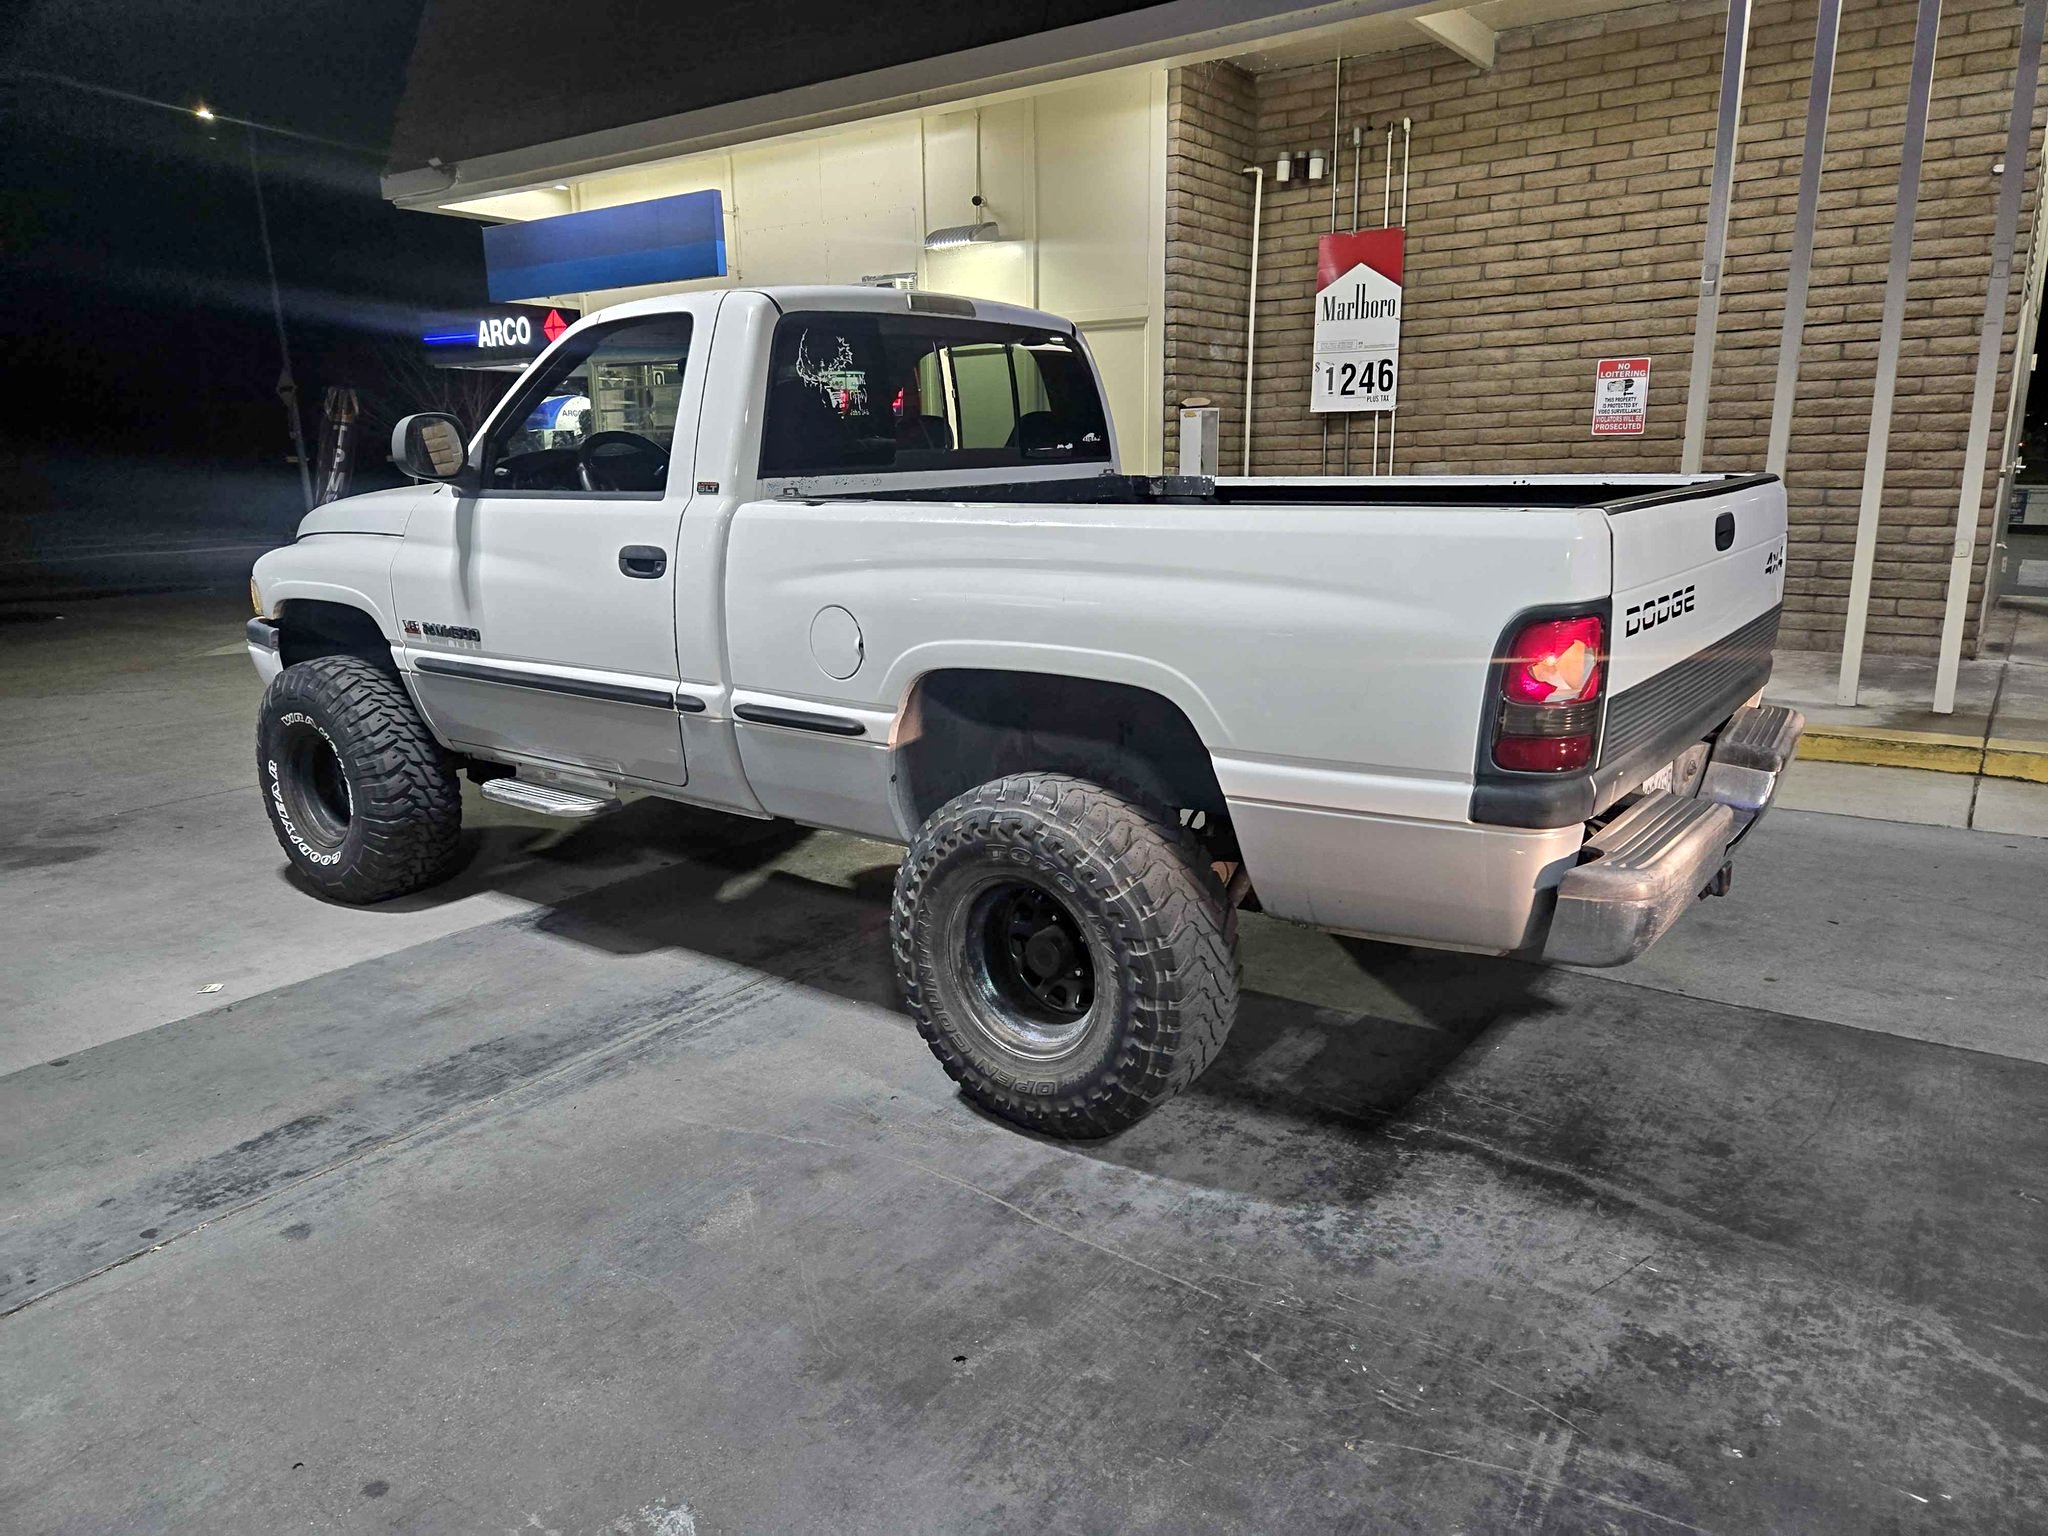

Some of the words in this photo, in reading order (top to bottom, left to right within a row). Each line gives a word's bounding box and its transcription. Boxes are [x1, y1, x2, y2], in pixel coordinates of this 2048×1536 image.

[1322, 283, 1396, 321] Marlboro
[478, 316, 531, 348] ARCO
[1600, 370, 1646, 378] LOITERING
[1626, 585, 1695, 637] DODGE
[268, 760, 341, 865] GOODYEAR
[975, 1057, 1056, 1096] OPEN
